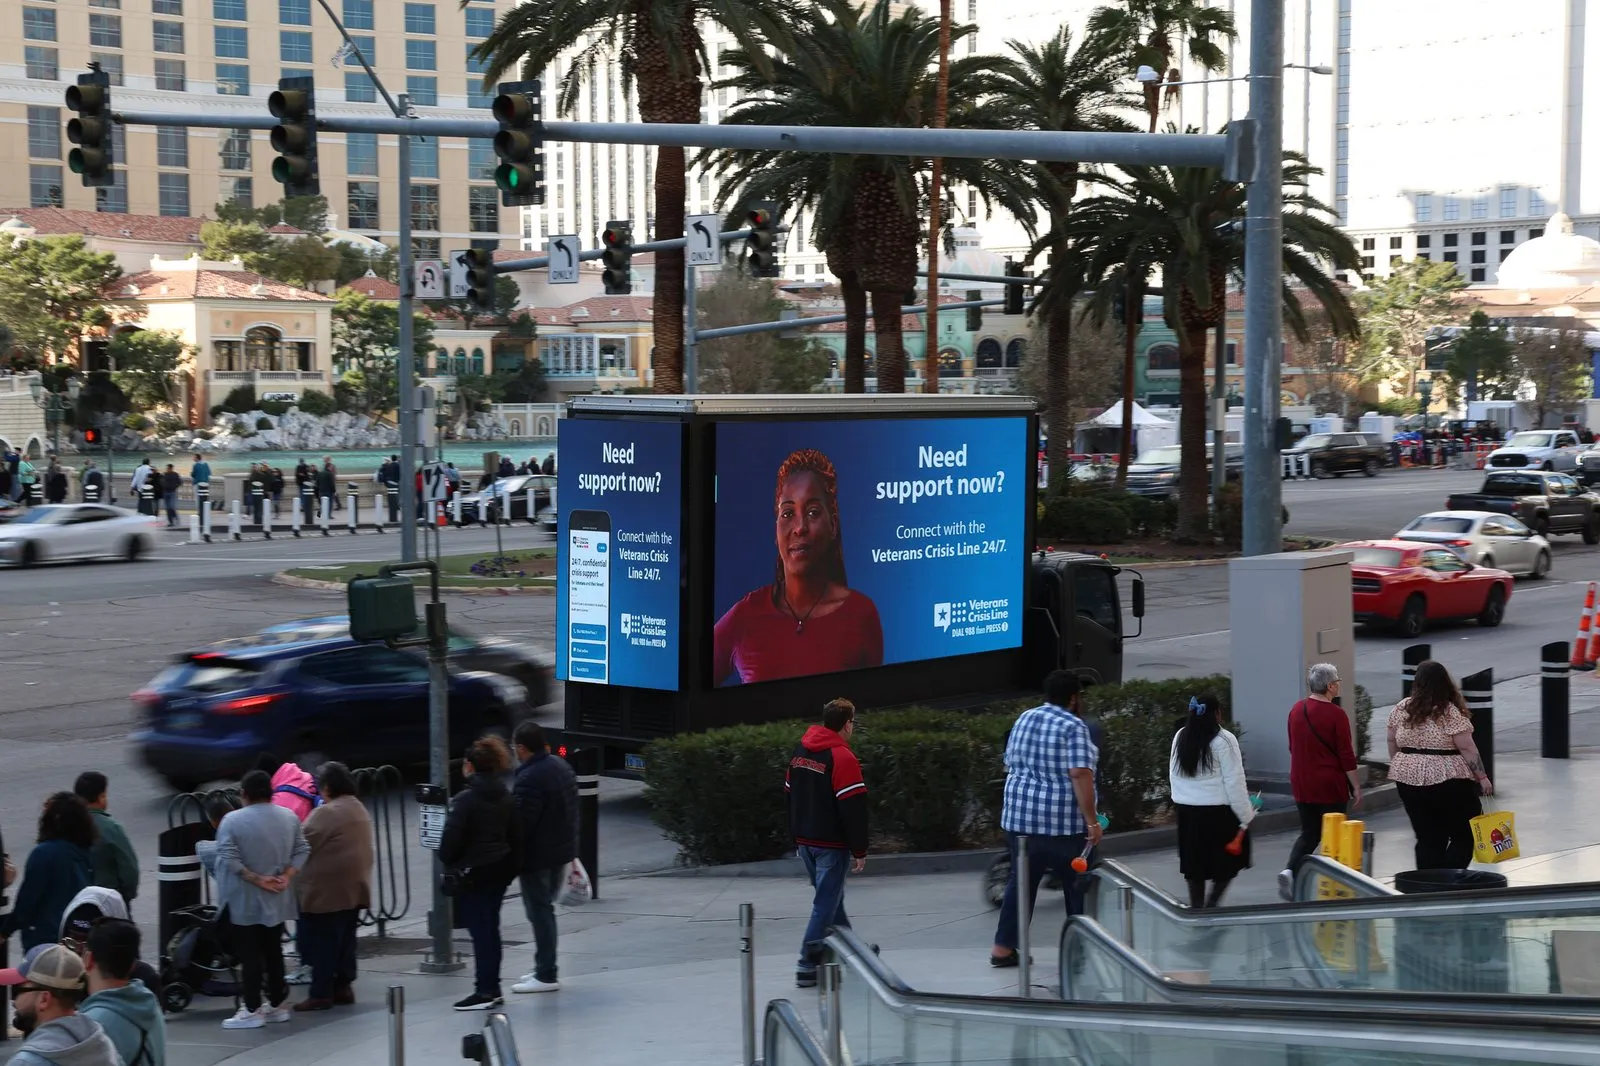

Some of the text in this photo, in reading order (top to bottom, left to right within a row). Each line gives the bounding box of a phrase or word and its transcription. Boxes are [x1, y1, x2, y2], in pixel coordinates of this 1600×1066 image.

[691, 251, 714, 261] ONLY
[551, 270, 573, 280] ONLY
[603, 442, 635, 464] Need
[918, 443, 968, 469] Need
[578, 471, 662, 496] support now?
[876, 470, 1005, 504] support now?
[617, 529, 673, 545] Connect with the
[896, 519, 986, 540] Connect with the
[619, 547, 669, 563] Veterans Crisis
[872, 539, 1007, 563] Veterans Crisis Line 24/7.
[583, 569, 599, 579] support
[628, 566, 661, 581] Line 24/7.
[968, 598, 1009, 611] Veterans
[641, 614, 667, 626] Veterans
[967, 608, 1009, 623] Crisis Line
[640, 625, 667, 637] Crisis Line
[951, 628, 965, 638] DIAL
[964, 626, 976, 636] 988
[986, 622, 1002, 633] PRESS
